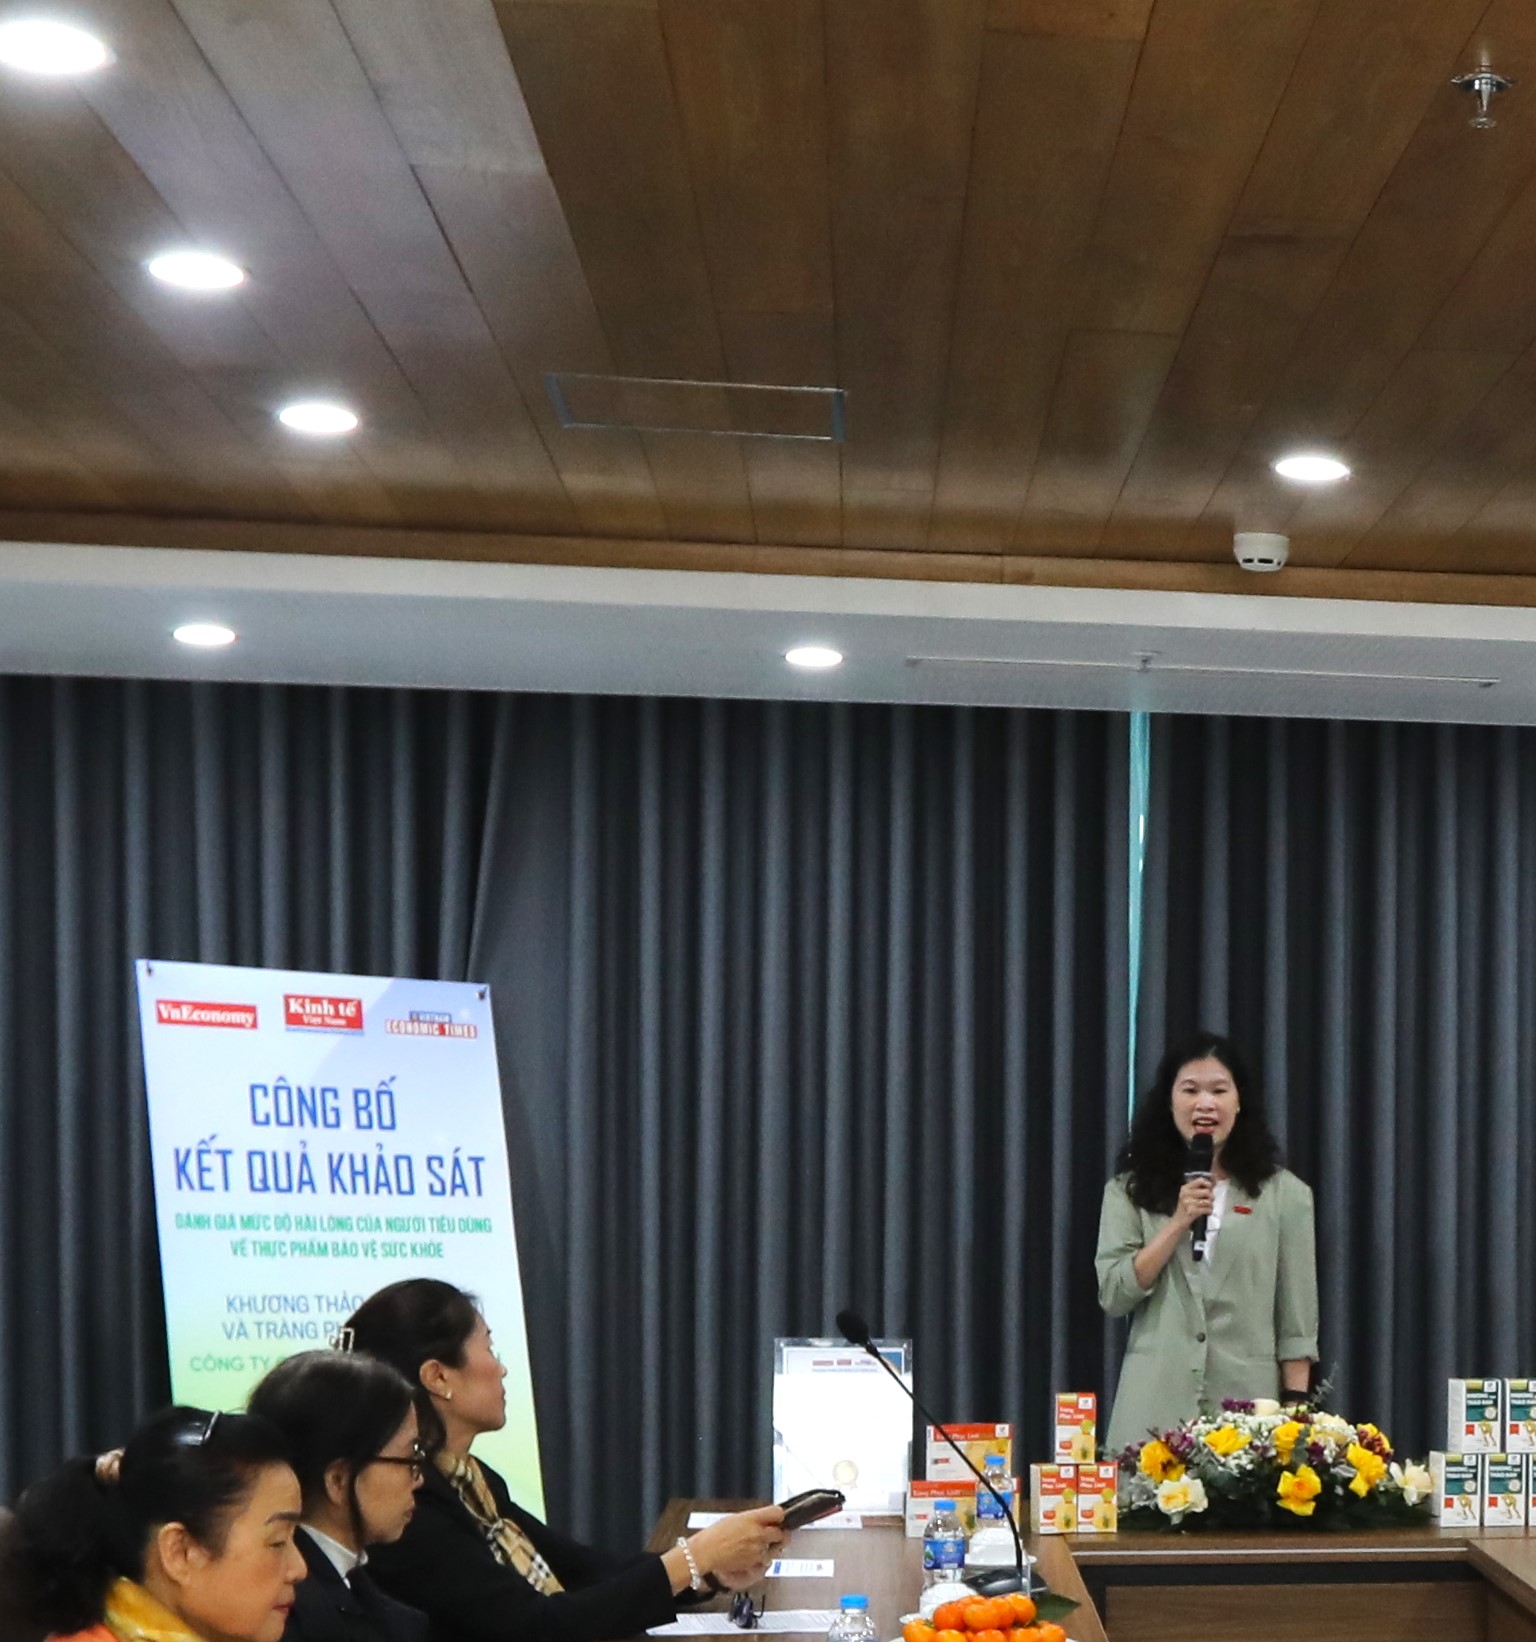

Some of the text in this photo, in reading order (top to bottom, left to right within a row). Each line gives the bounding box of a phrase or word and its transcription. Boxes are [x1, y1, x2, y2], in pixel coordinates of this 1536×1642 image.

[157, 1002, 255, 1027] VnEconomy
[287, 997, 357, 1018] Kinh tế
[249, 1075, 398, 1131] CÔNG BỐ
[173, 1133, 486, 1198] KẾT QUẢ KHẢO SÁT
[226, 1292, 310, 1316] KHƯƠNG
[222, 1318, 250, 1341] VÀ
[254, 1316, 320, 1341] TRÀNG
[189, 1352, 245, 1373] CÔNG
